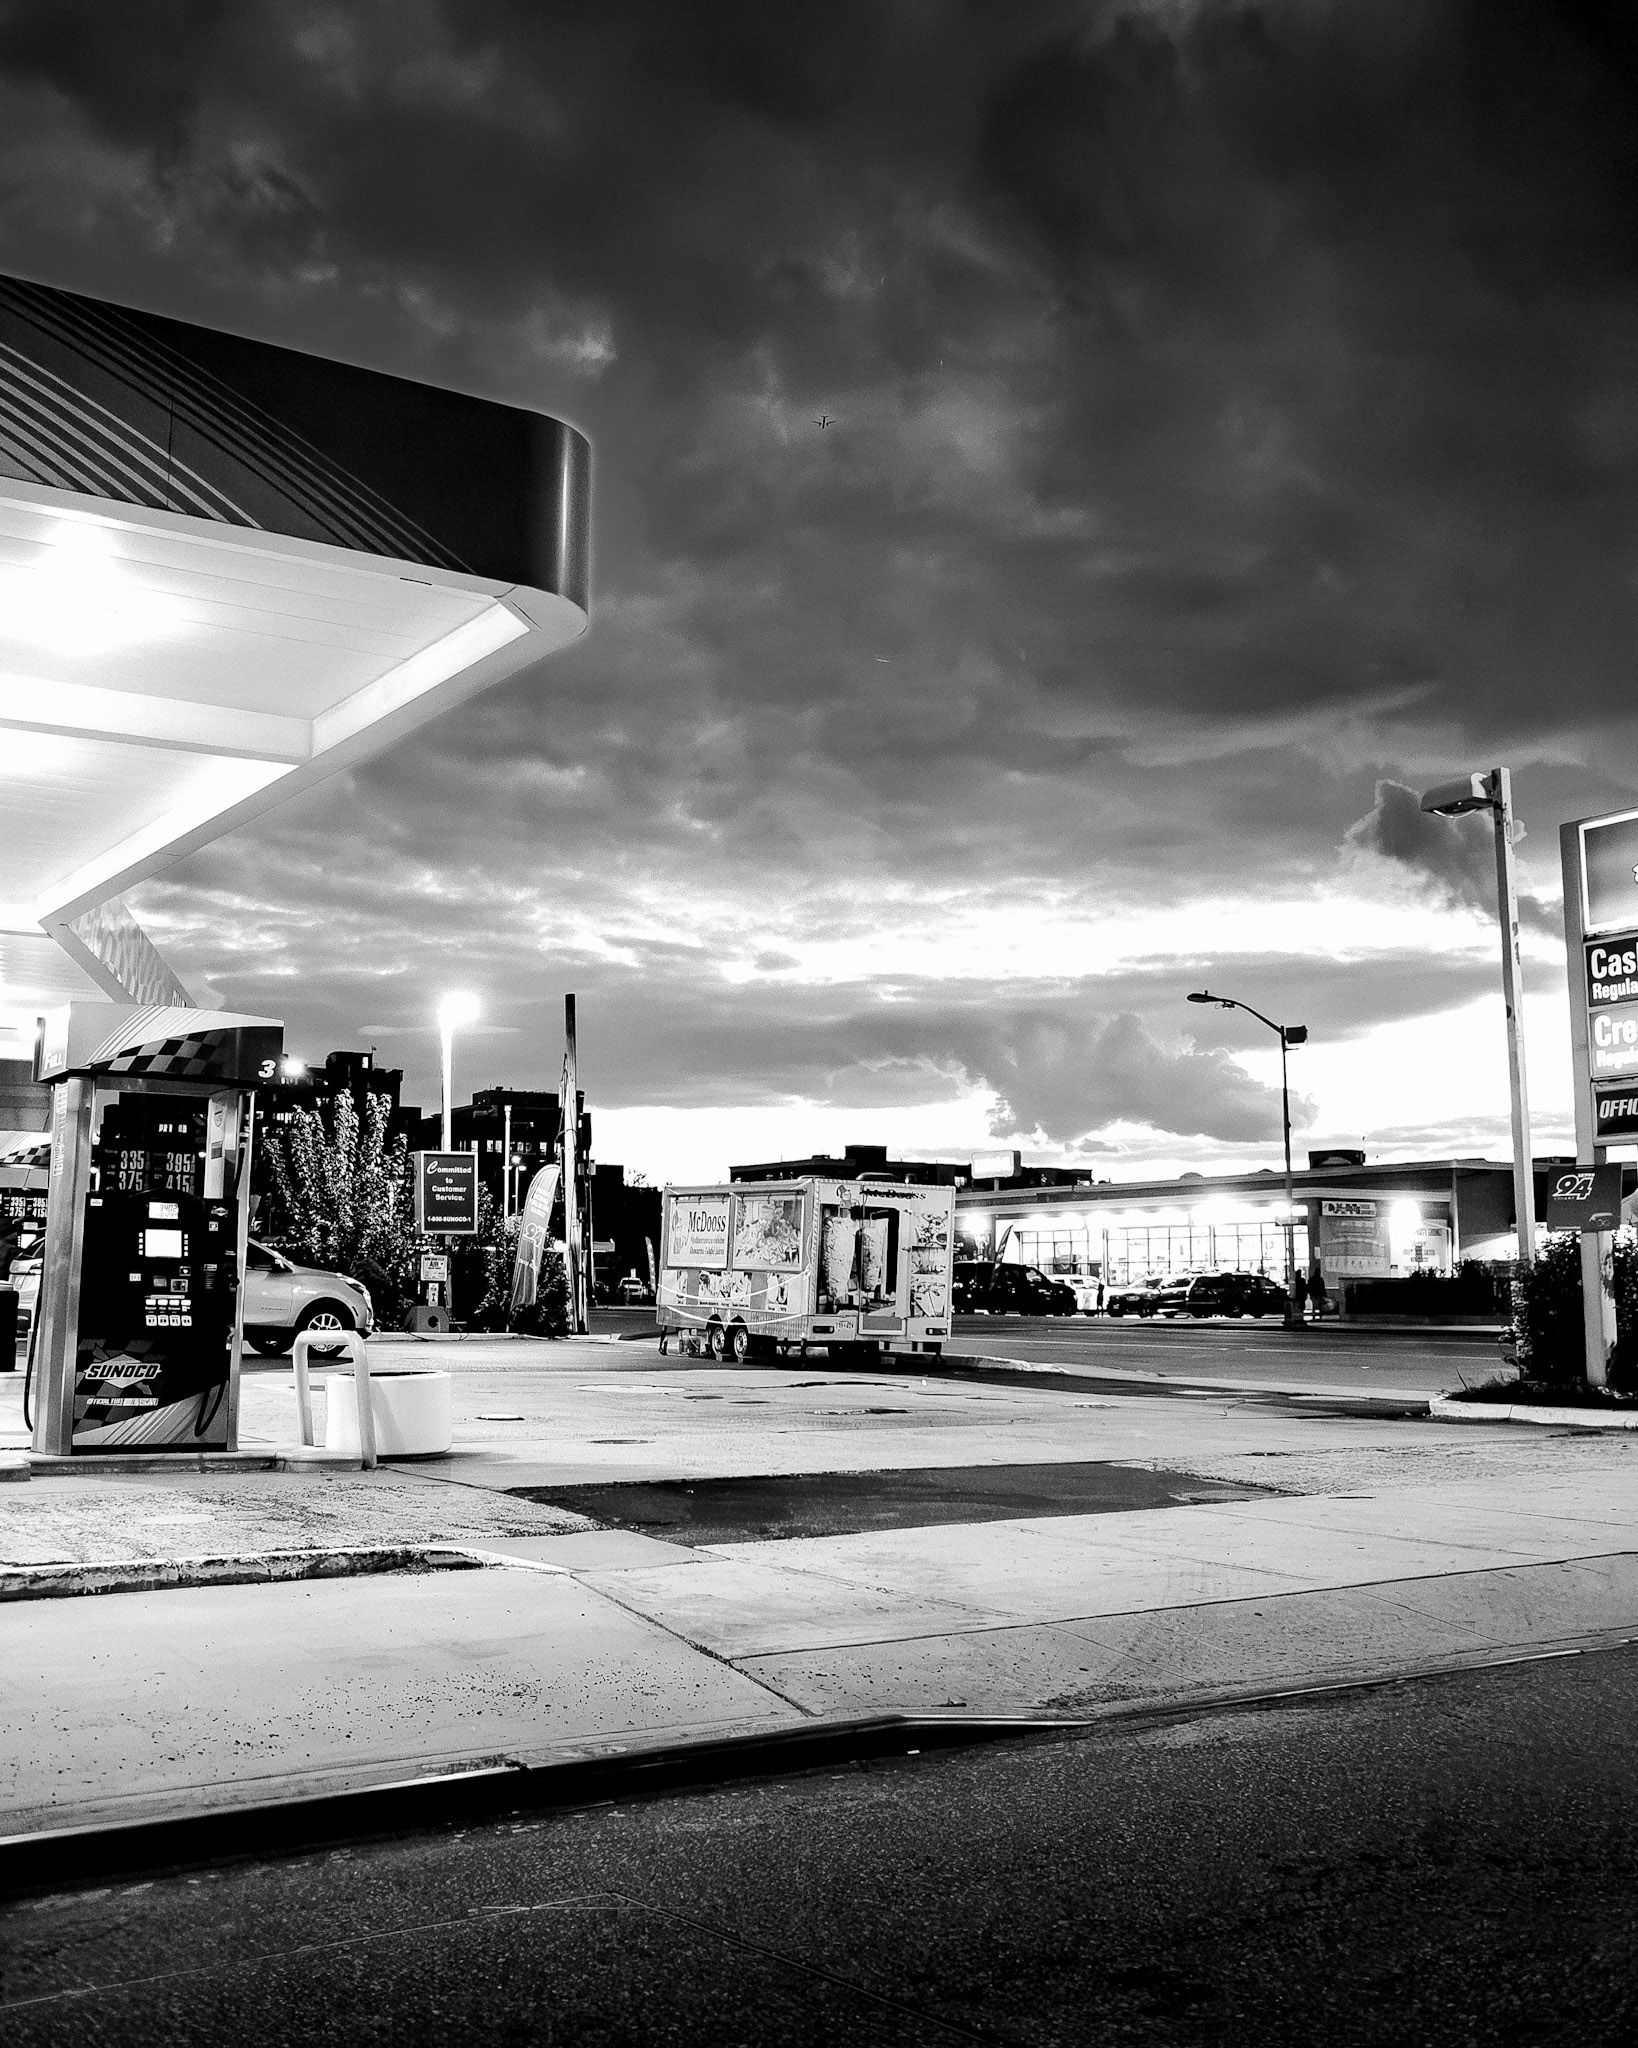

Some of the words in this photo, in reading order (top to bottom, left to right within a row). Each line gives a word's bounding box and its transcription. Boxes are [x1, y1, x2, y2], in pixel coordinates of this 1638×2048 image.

[1591, 941, 1638, 979] Cas
[1594, 1015, 1638, 1047] Cre
[258, 1060, 276, 1078] 3
[120, 1150, 145, 1170] 335
[166, 1152, 191, 1173] 395
[426, 1160, 472, 1175] Committed
[118, 1170, 143, 1191] 375
[1552, 1174, 1594, 1200] 94
[435, 1193, 465, 1201] Service.
[689, 1210, 726, 1232] McDooss
[87, 1364, 159, 1378] SUNOCO
